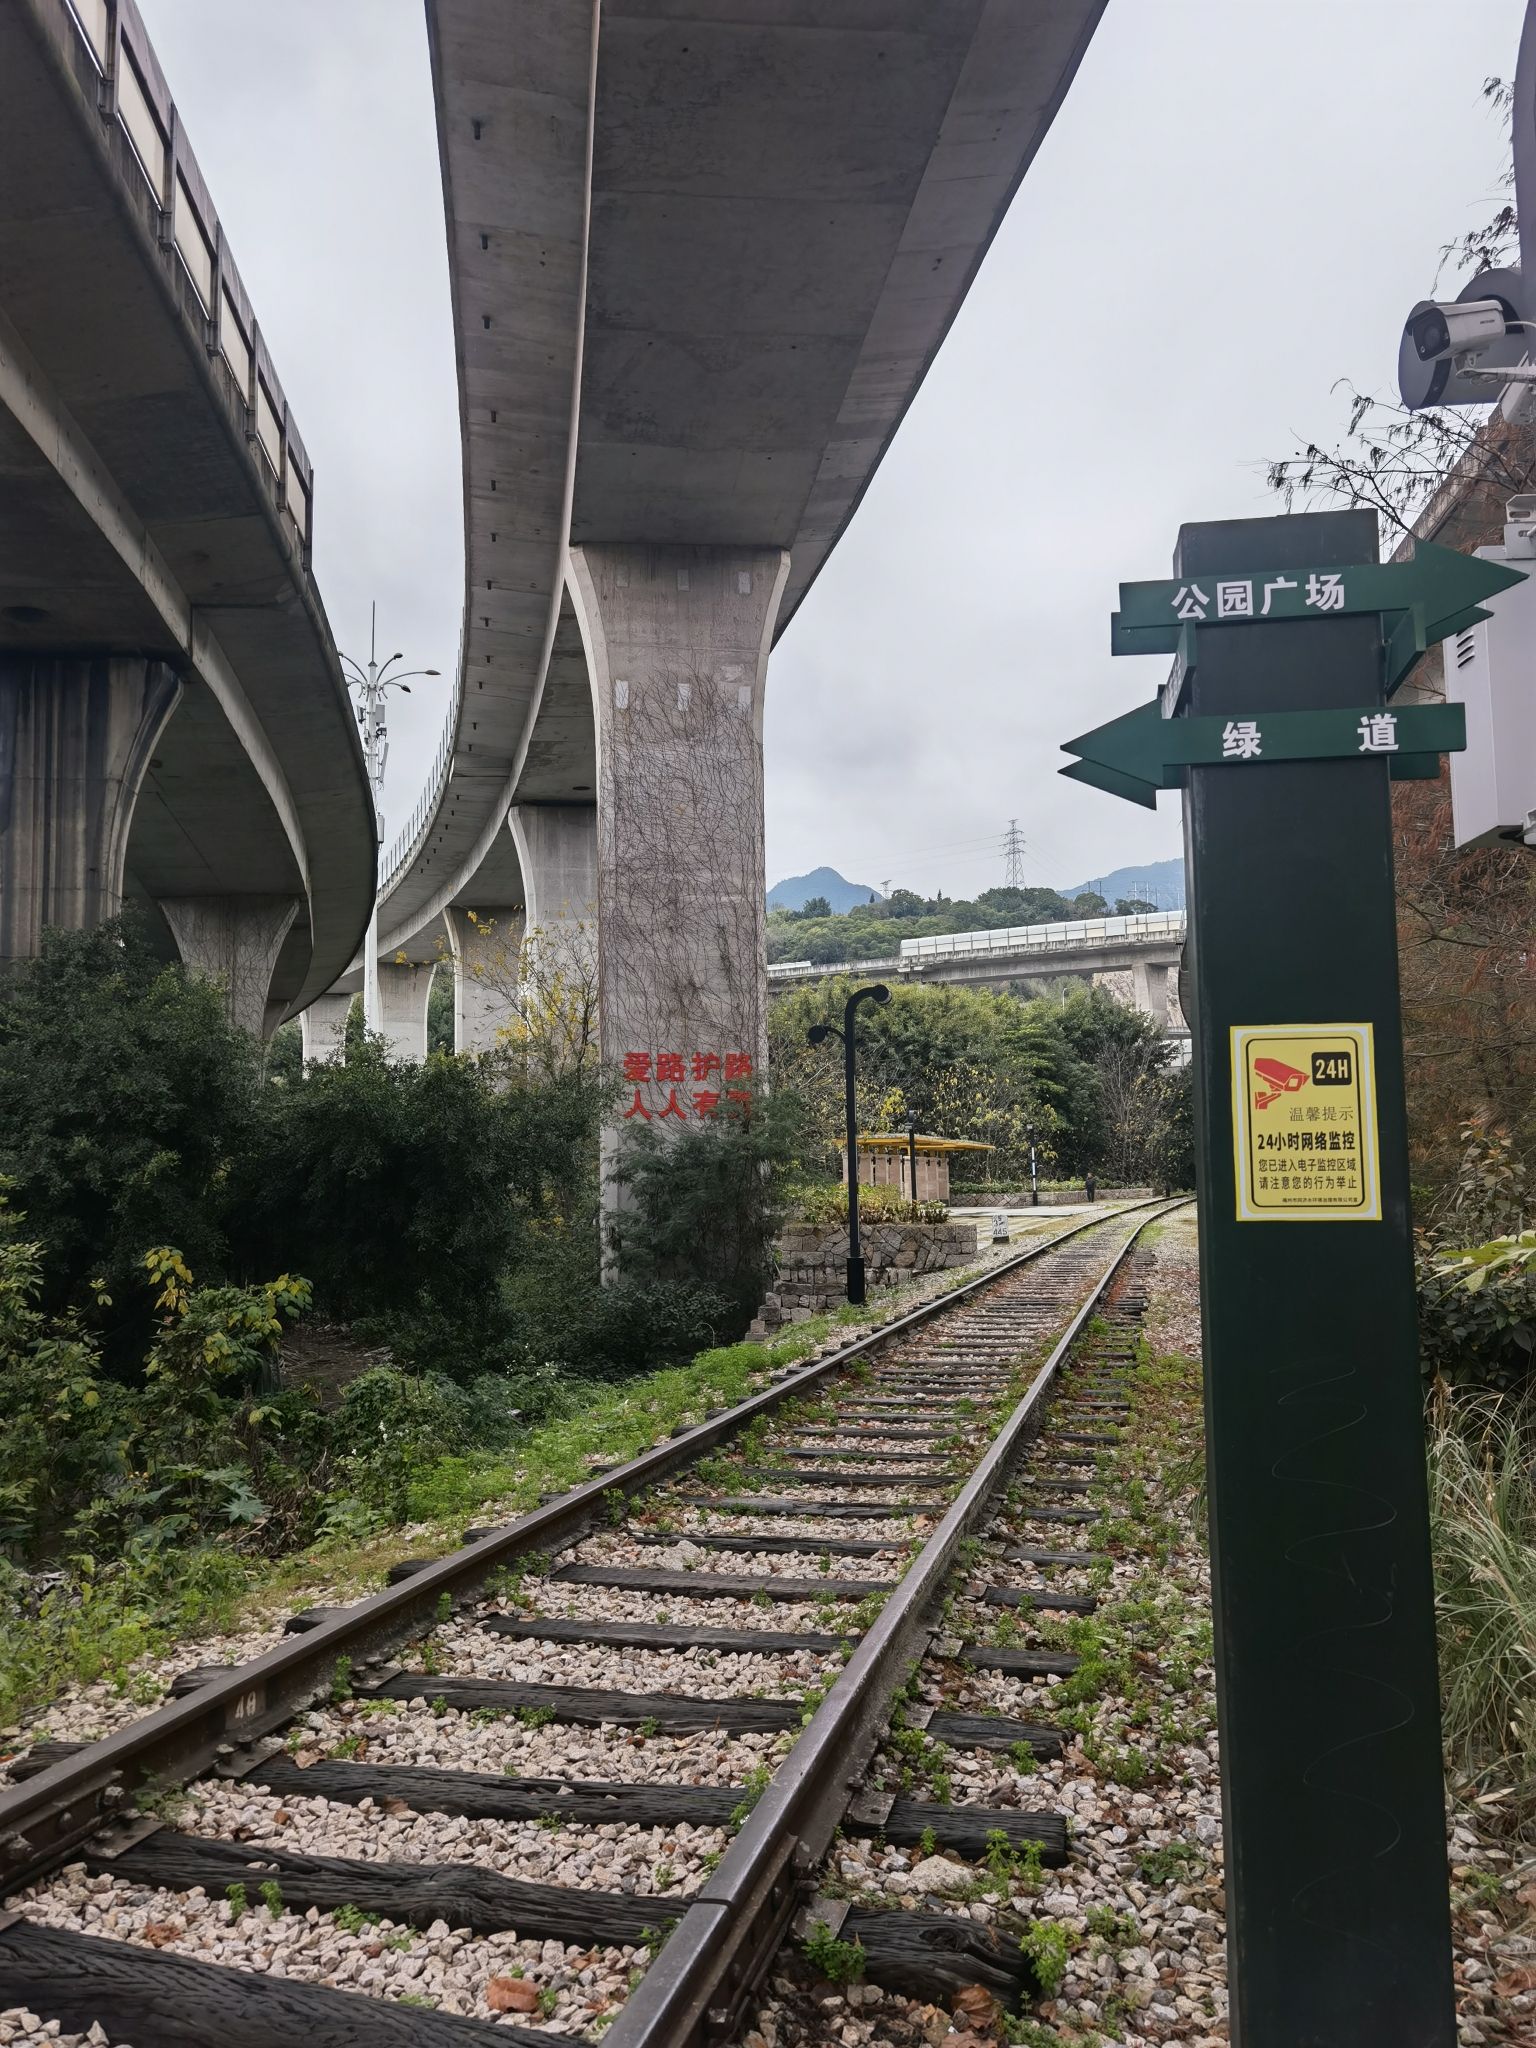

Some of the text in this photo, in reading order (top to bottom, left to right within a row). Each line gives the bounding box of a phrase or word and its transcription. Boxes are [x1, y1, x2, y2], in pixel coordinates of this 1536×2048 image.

[1171, 573, 1345, 620] 公园广场
[1222, 713, 1399, 759] 绿道
[623, 1052, 752, 1082] 爱路护路
[1315, 1059, 1349, 1079] 24H
[1289, 1106, 1354, 1122] 温馨提示
[1257, 1130, 1356, 1151] 24小时网络监控
[1258, 1158, 1357, 1172] 您已进入电子监控区域
[1259, 1175, 1357, 1190] 请注意您的行为举止
